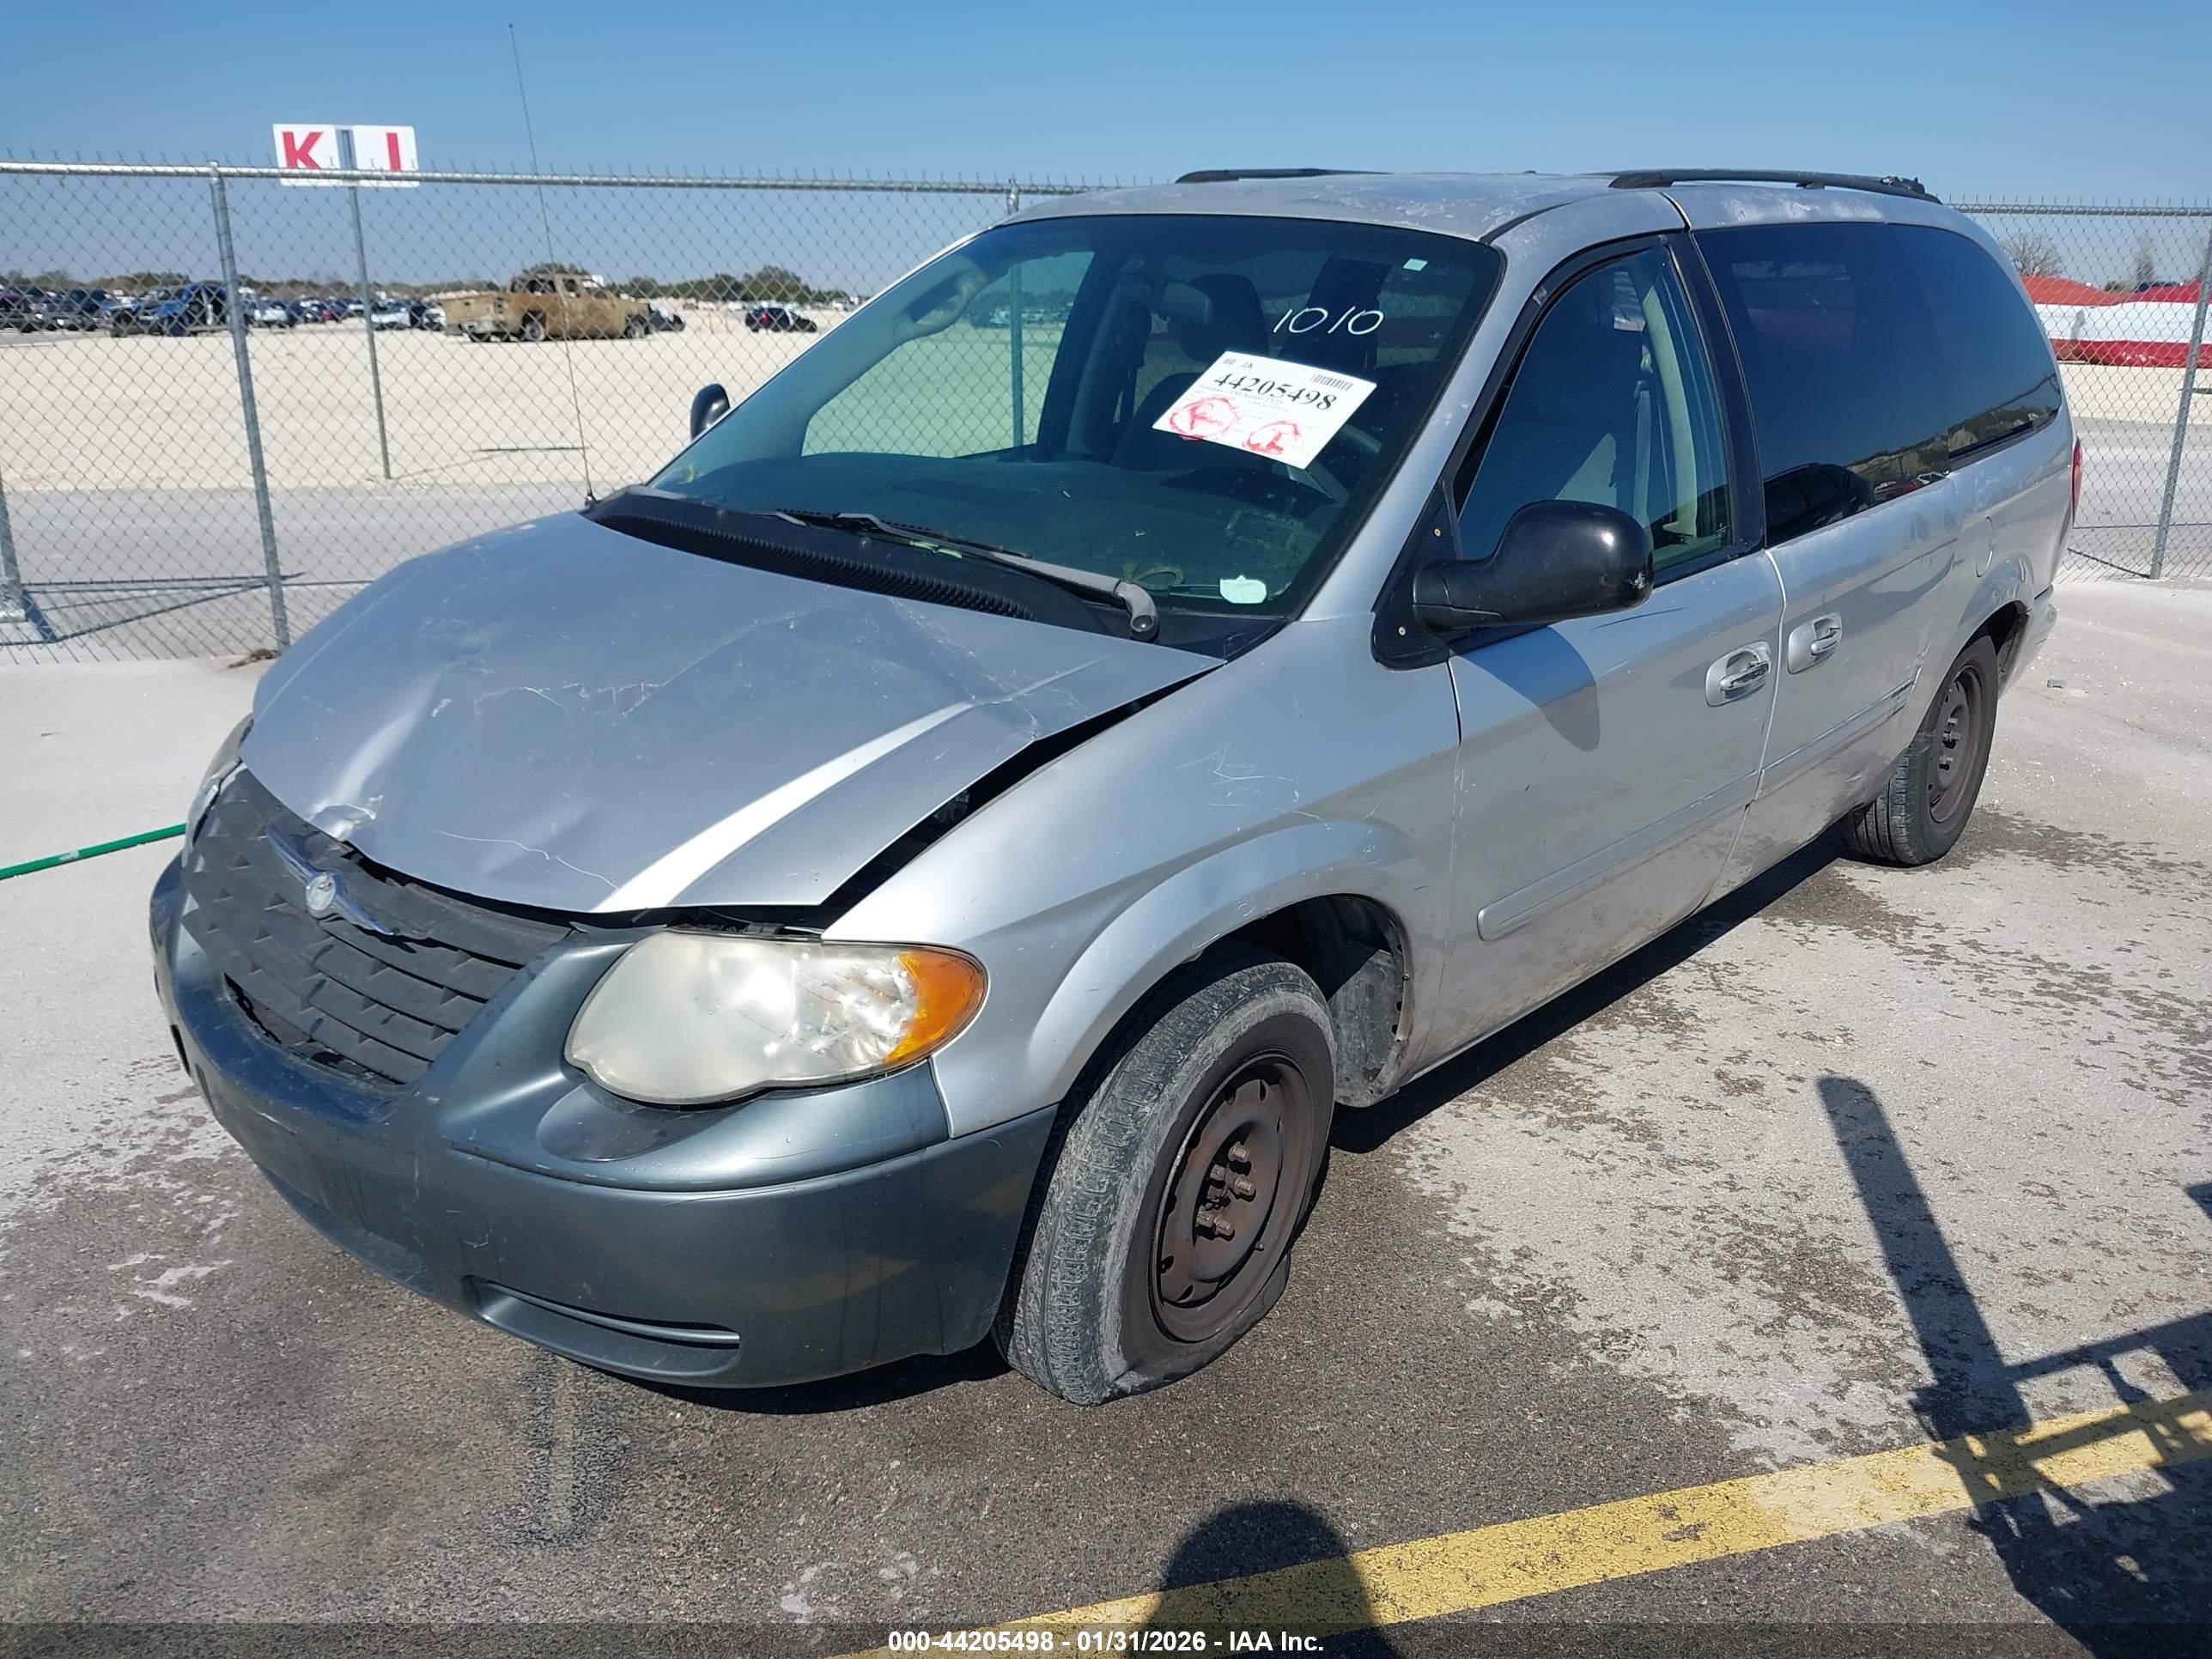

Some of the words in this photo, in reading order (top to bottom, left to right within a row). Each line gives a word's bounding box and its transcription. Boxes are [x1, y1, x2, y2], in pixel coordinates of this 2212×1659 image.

[282, 131, 324, 170] K
[1273, 306, 1384, 335] 1010
[1213, 373, 1337, 410] 44205498
